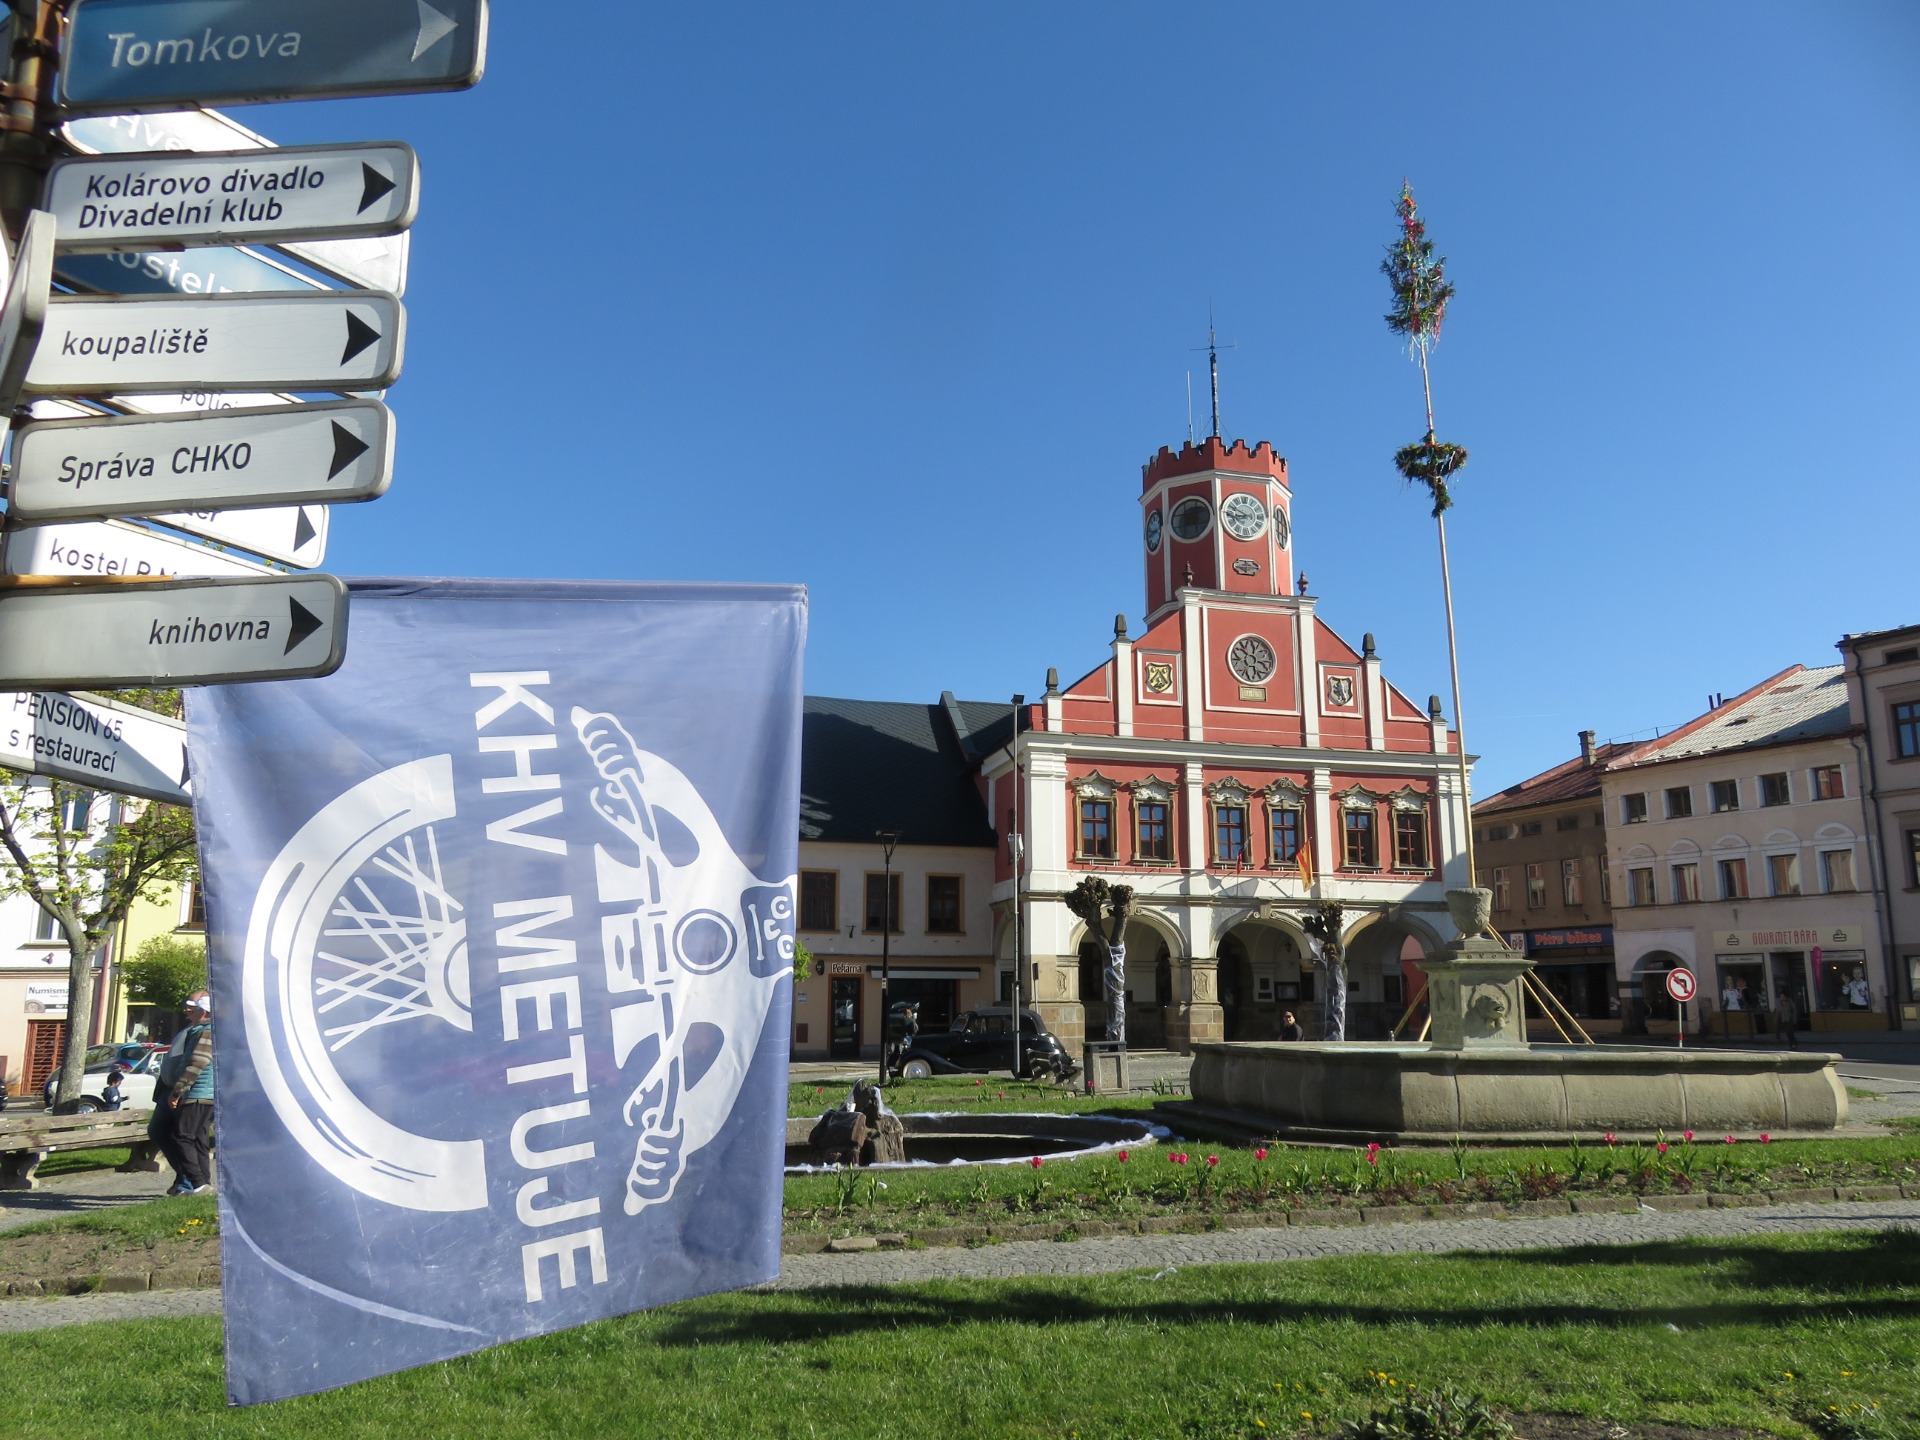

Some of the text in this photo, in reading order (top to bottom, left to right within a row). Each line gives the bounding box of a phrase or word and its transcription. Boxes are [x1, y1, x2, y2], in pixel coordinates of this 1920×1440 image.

[107, 28, 301, 68] Tomkova
[85, 165, 325, 199] Kolárovo divadlo
[78, 197, 283, 229] Divadelní klub
[61, 328, 209, 361] koupaliště
[57, 441, 252, 489] Správa CHKO
[50, 538, 128, 576] kostel
[149, 616, 270, 645] knihovna
[13, 690, 123, 742] PENSION 65
[8, 729, 118, 773] s restaurací
[1566, 931, 1602, 944] bikes
[831, 962, 861, 974] Pekárna
[469, 670, 609, 1304] KHV METUJE
